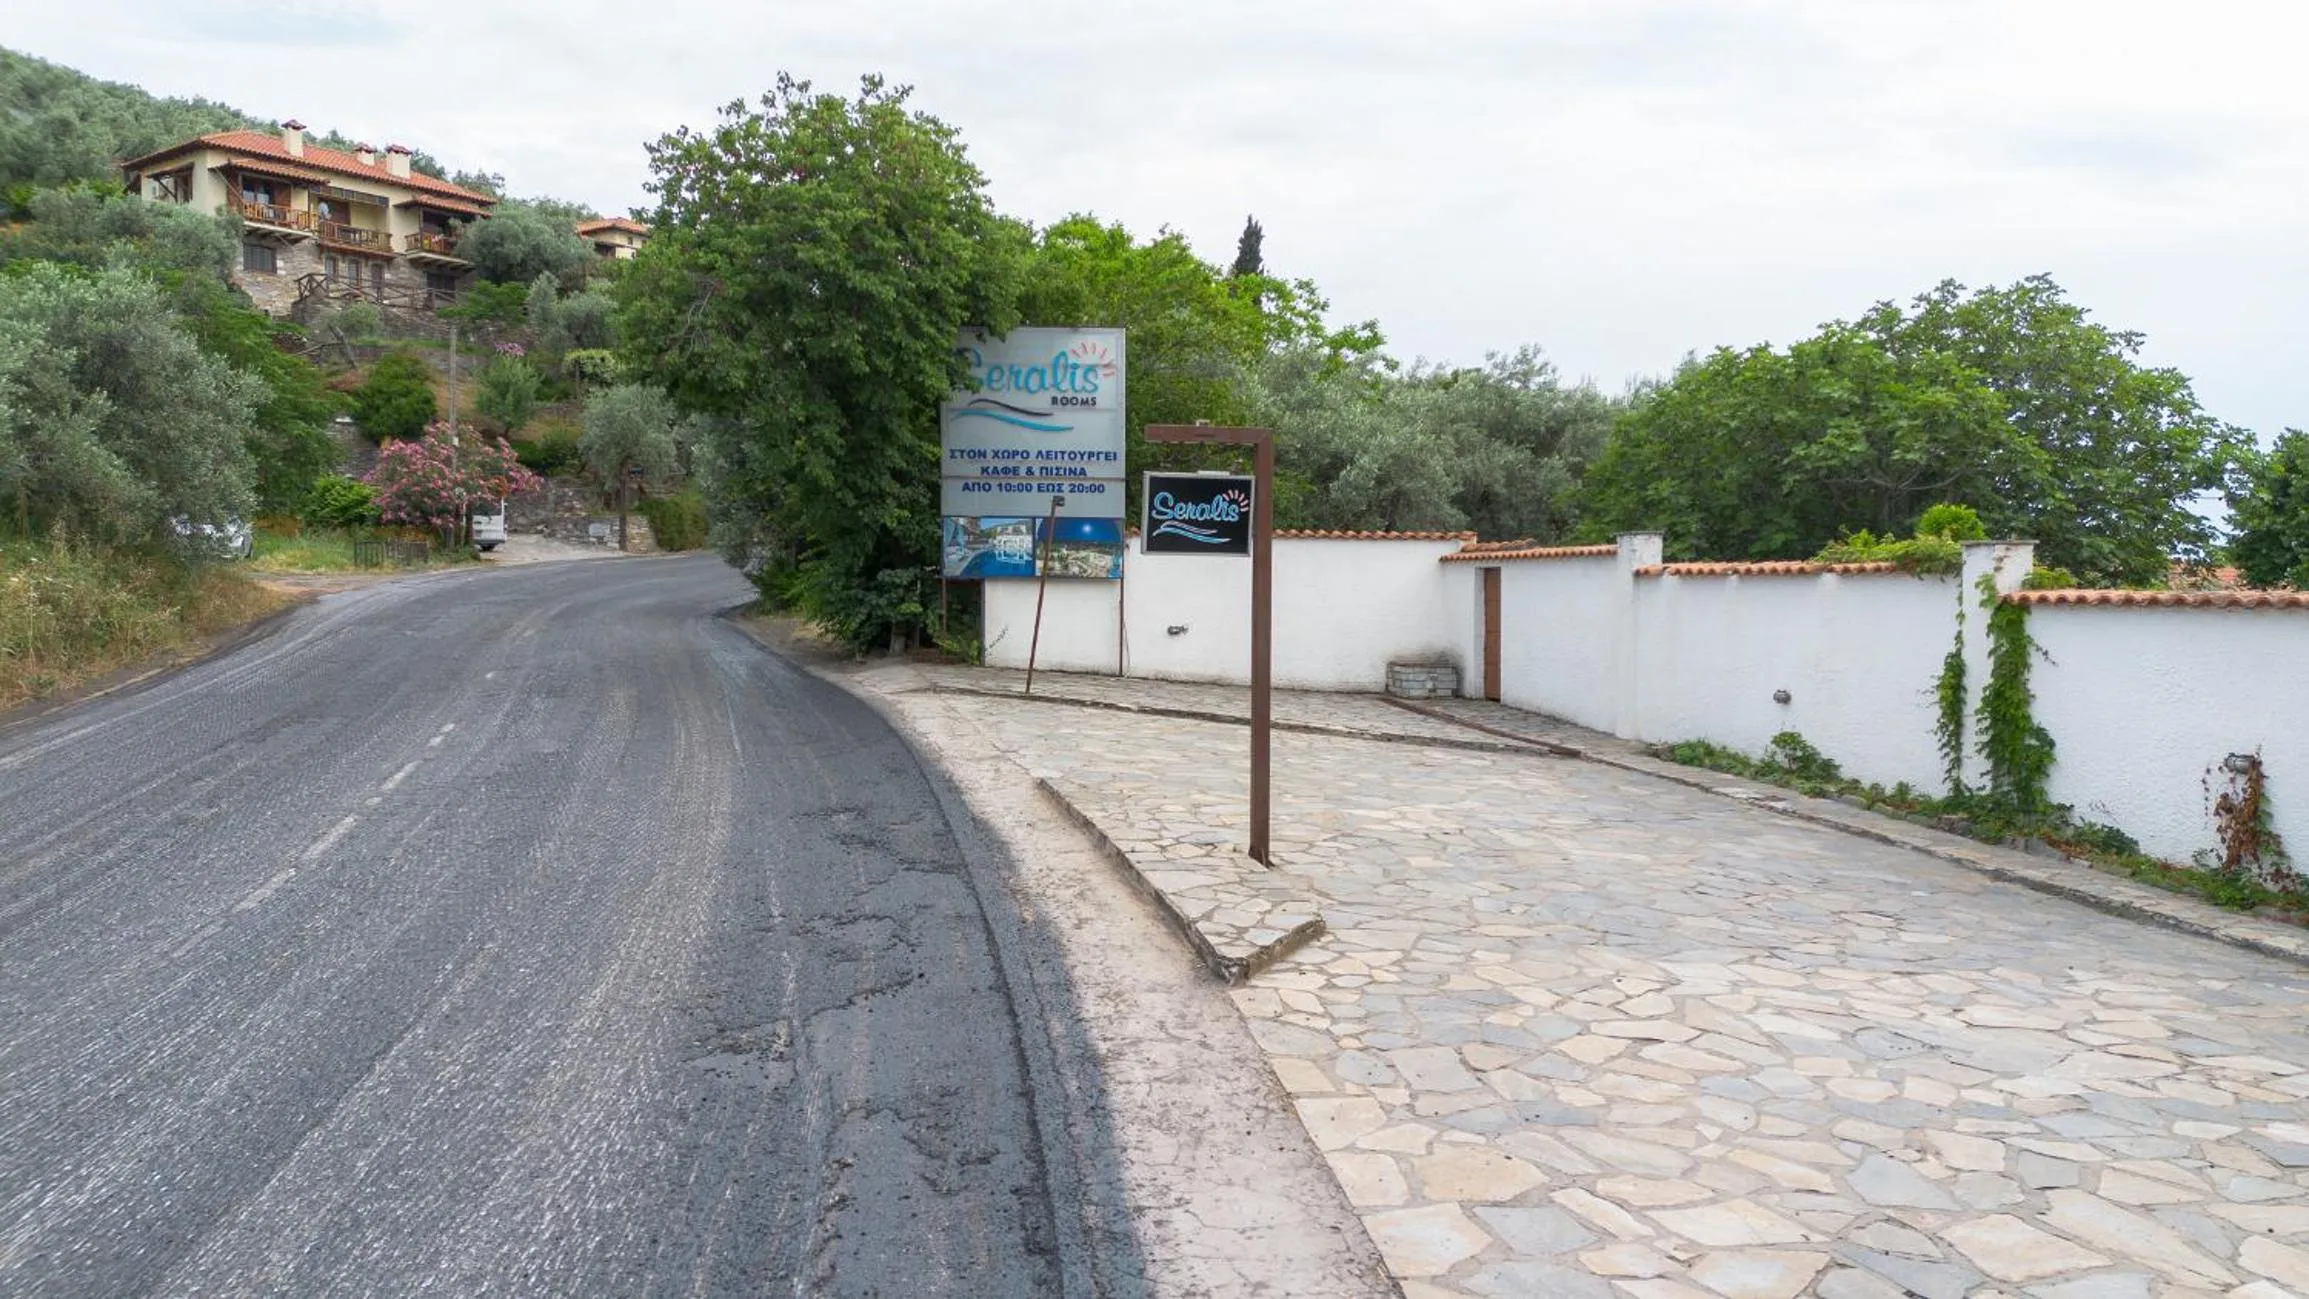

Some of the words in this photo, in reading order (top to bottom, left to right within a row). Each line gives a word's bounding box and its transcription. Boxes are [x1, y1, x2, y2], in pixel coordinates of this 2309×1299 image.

[1051, 396, 1097, 407] ROOMS
[949, 449, 986, 460] ΣΤΟΝ
[991, 449, 1030, 460] ΧΩΡΟ
[1035, 450, 1117, 461] ΛΕΙΤΟΥΡΓΕΙ
[980, 466, 1020, 477] ΚΑΦΕ
[1025, 466, 1035, 477] &
[1039, 466, 1088, 477] ΠΙΣΙΝΑ
[961, 482, 992, 493] ΑΠΟ
[998, 482, 1033, 493] 10:00
[1069, 483, 1105, 494] 20:00
[1151, 491, 1240, 522] Seralis
